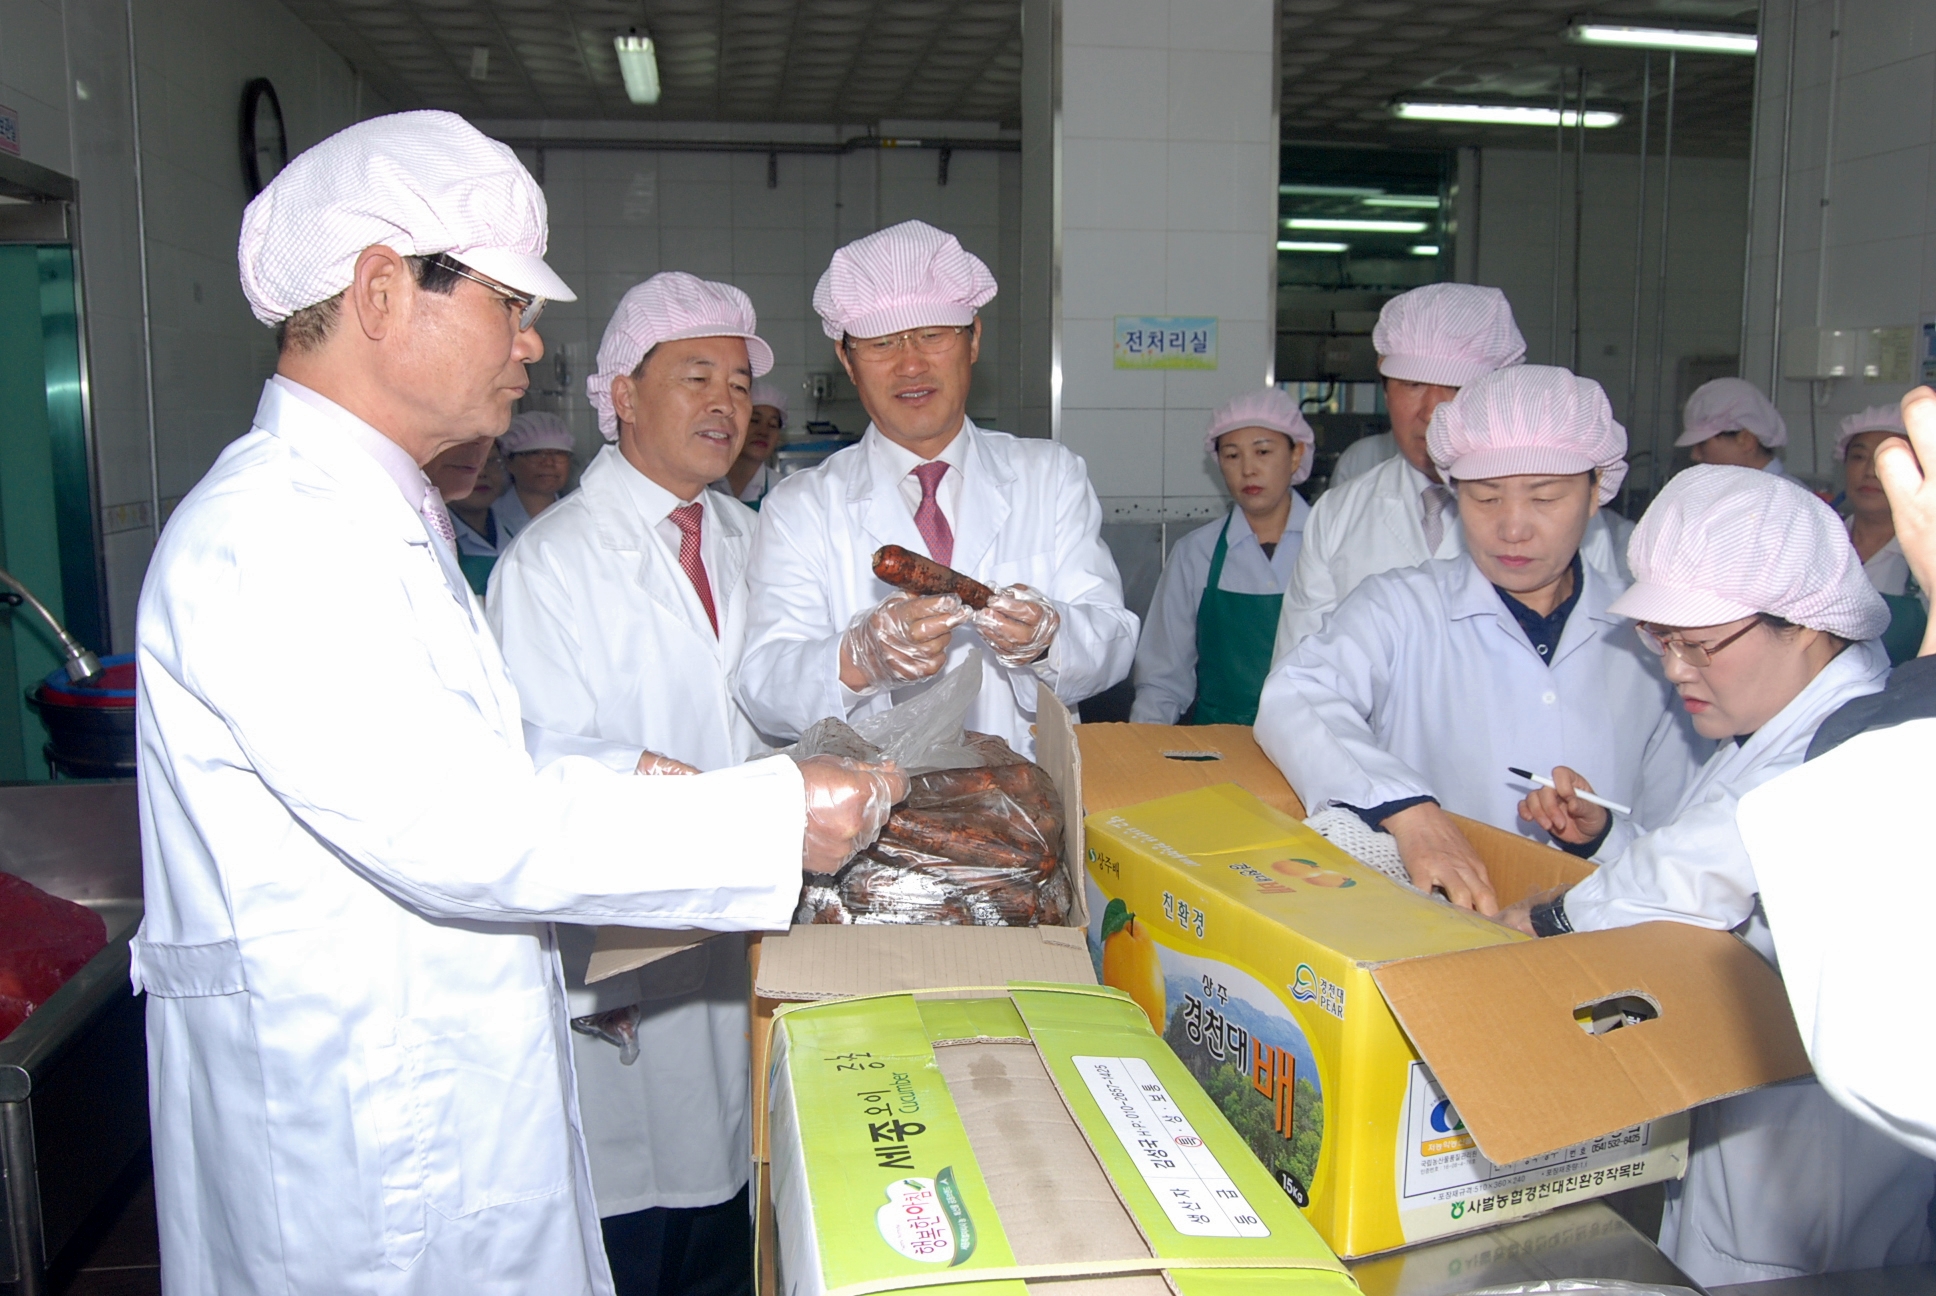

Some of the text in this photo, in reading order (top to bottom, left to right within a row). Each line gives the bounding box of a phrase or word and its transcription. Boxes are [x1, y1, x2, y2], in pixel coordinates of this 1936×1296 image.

[1126, 330, 1207, 353] 전처리실
[1098, 853, 1119, 880] 상주배
[1162, 892, 1204, 937] 친환경
[1202, 974, 1228, 1005] 상주
[1320, 978, 1344, 1004] 경천대
[1320, 996, 1343, 1019] PEAR
[889, 1072, 919, 1114] Cucumber
[857, 1089, 926, 1169] 세종 오이
[1138, 1139, 1176, 1169] 김성국
[1467, 1161, 1646, 1214] 사벌농협경천대친환경작목반
[1170, 1188, 1211, 1225] 생산자
